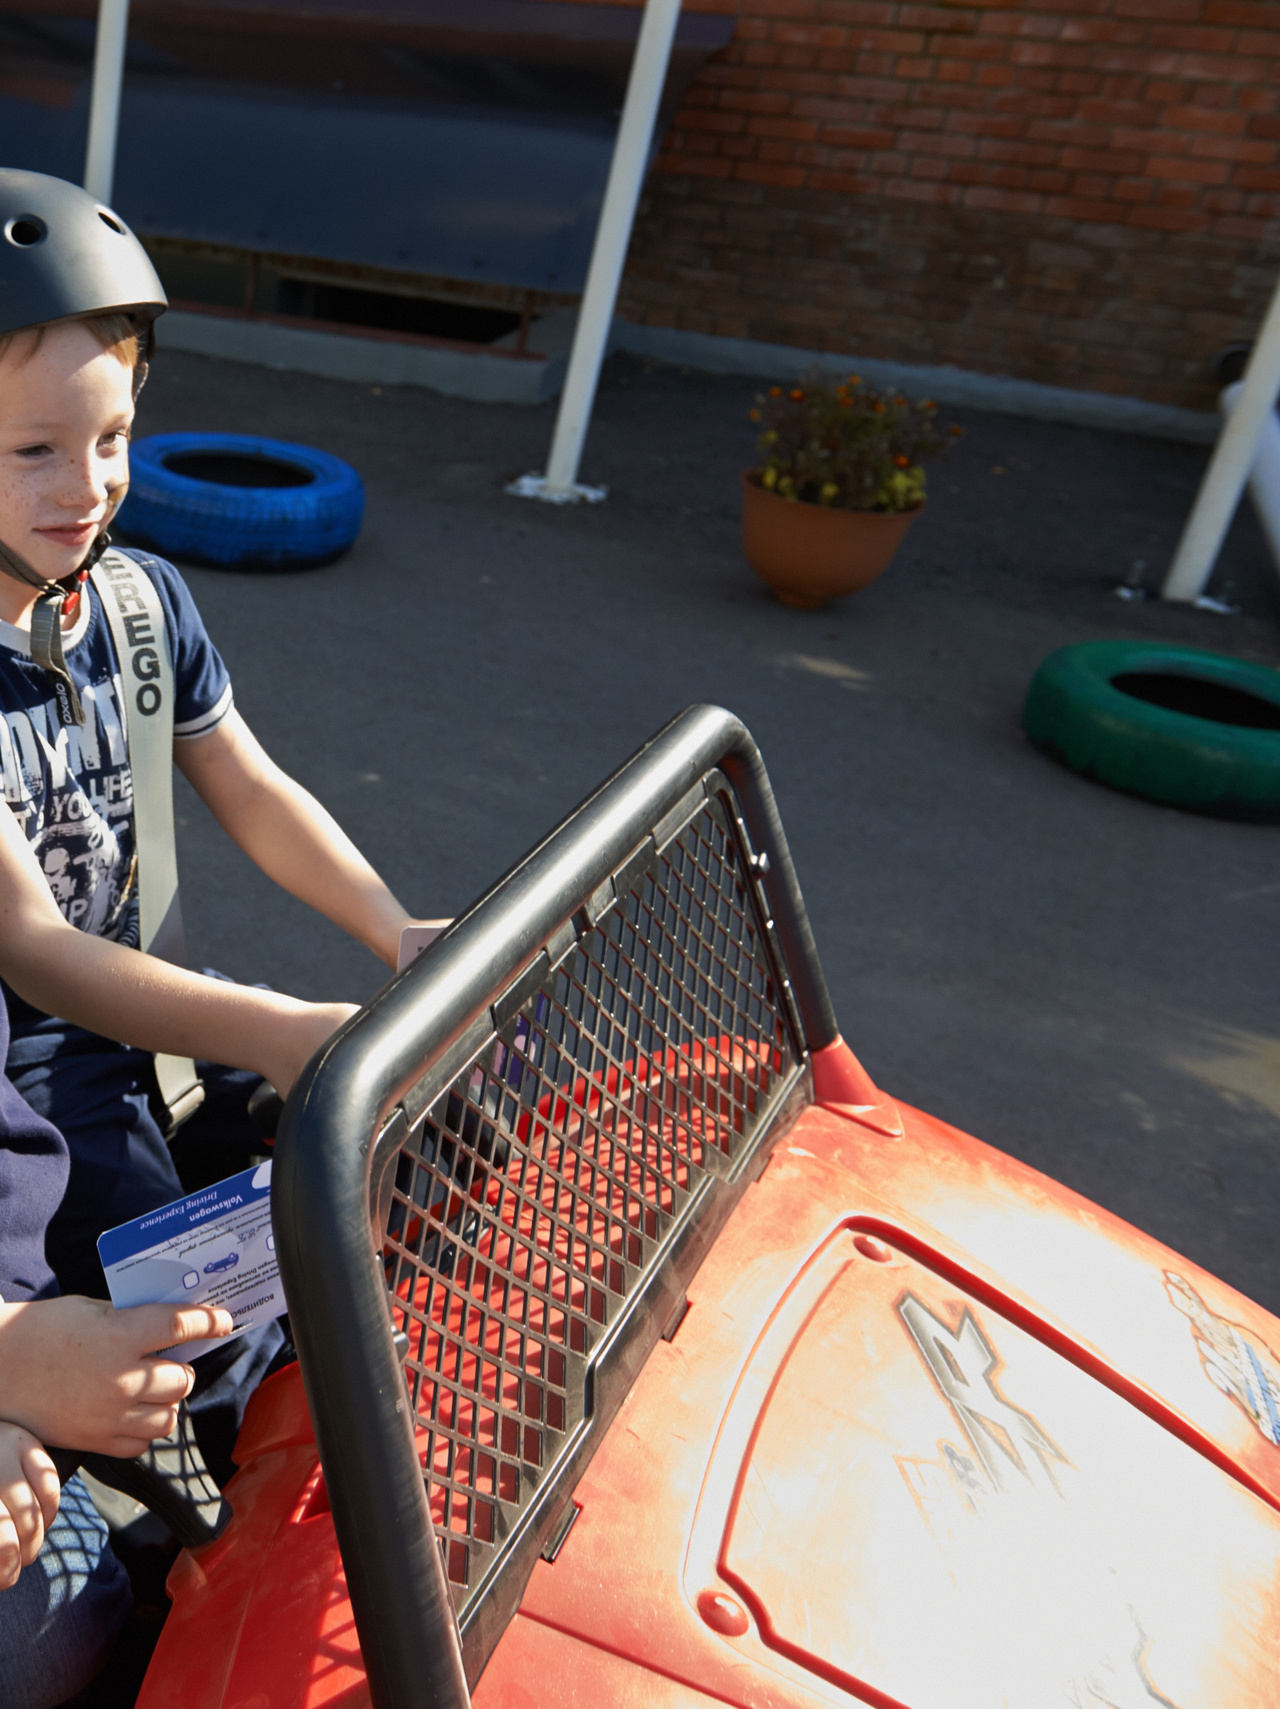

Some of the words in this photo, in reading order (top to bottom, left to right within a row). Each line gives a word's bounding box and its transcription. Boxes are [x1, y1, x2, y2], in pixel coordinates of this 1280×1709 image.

[55, 682, 73, 724] oxelo
[185, 1190, 218, 1211] Driving
[189, 1194, 243, 1223] Volkswagen
[139, 1205, 185, 1230] Experience
[231, 1293, 275, 1320] ВОДИТЕЛЬС
